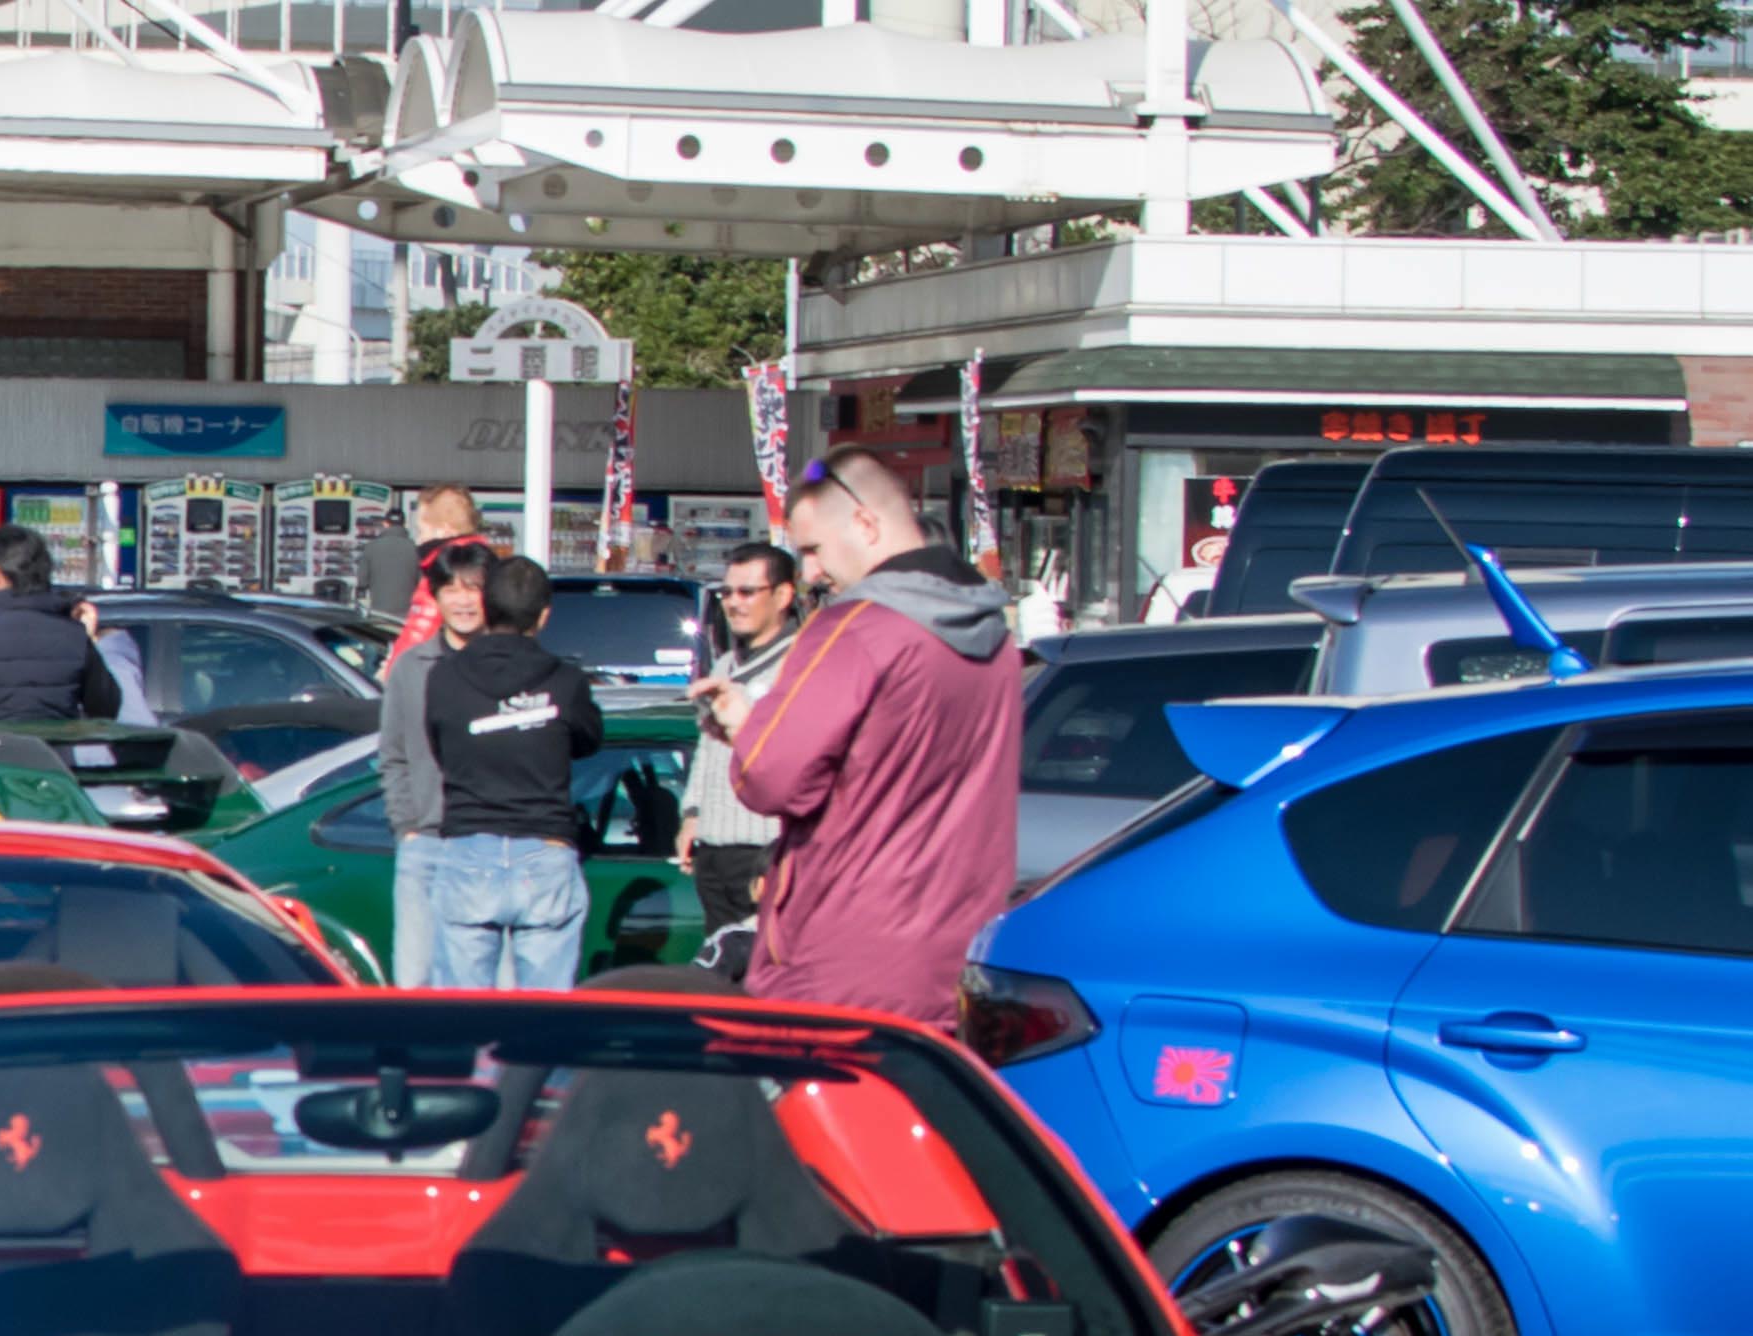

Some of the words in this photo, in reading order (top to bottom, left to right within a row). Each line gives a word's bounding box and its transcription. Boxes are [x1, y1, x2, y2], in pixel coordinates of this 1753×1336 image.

[121, 413, 269, 436] 自販機コーナー
[458, 417, 617, 451] DRNK
